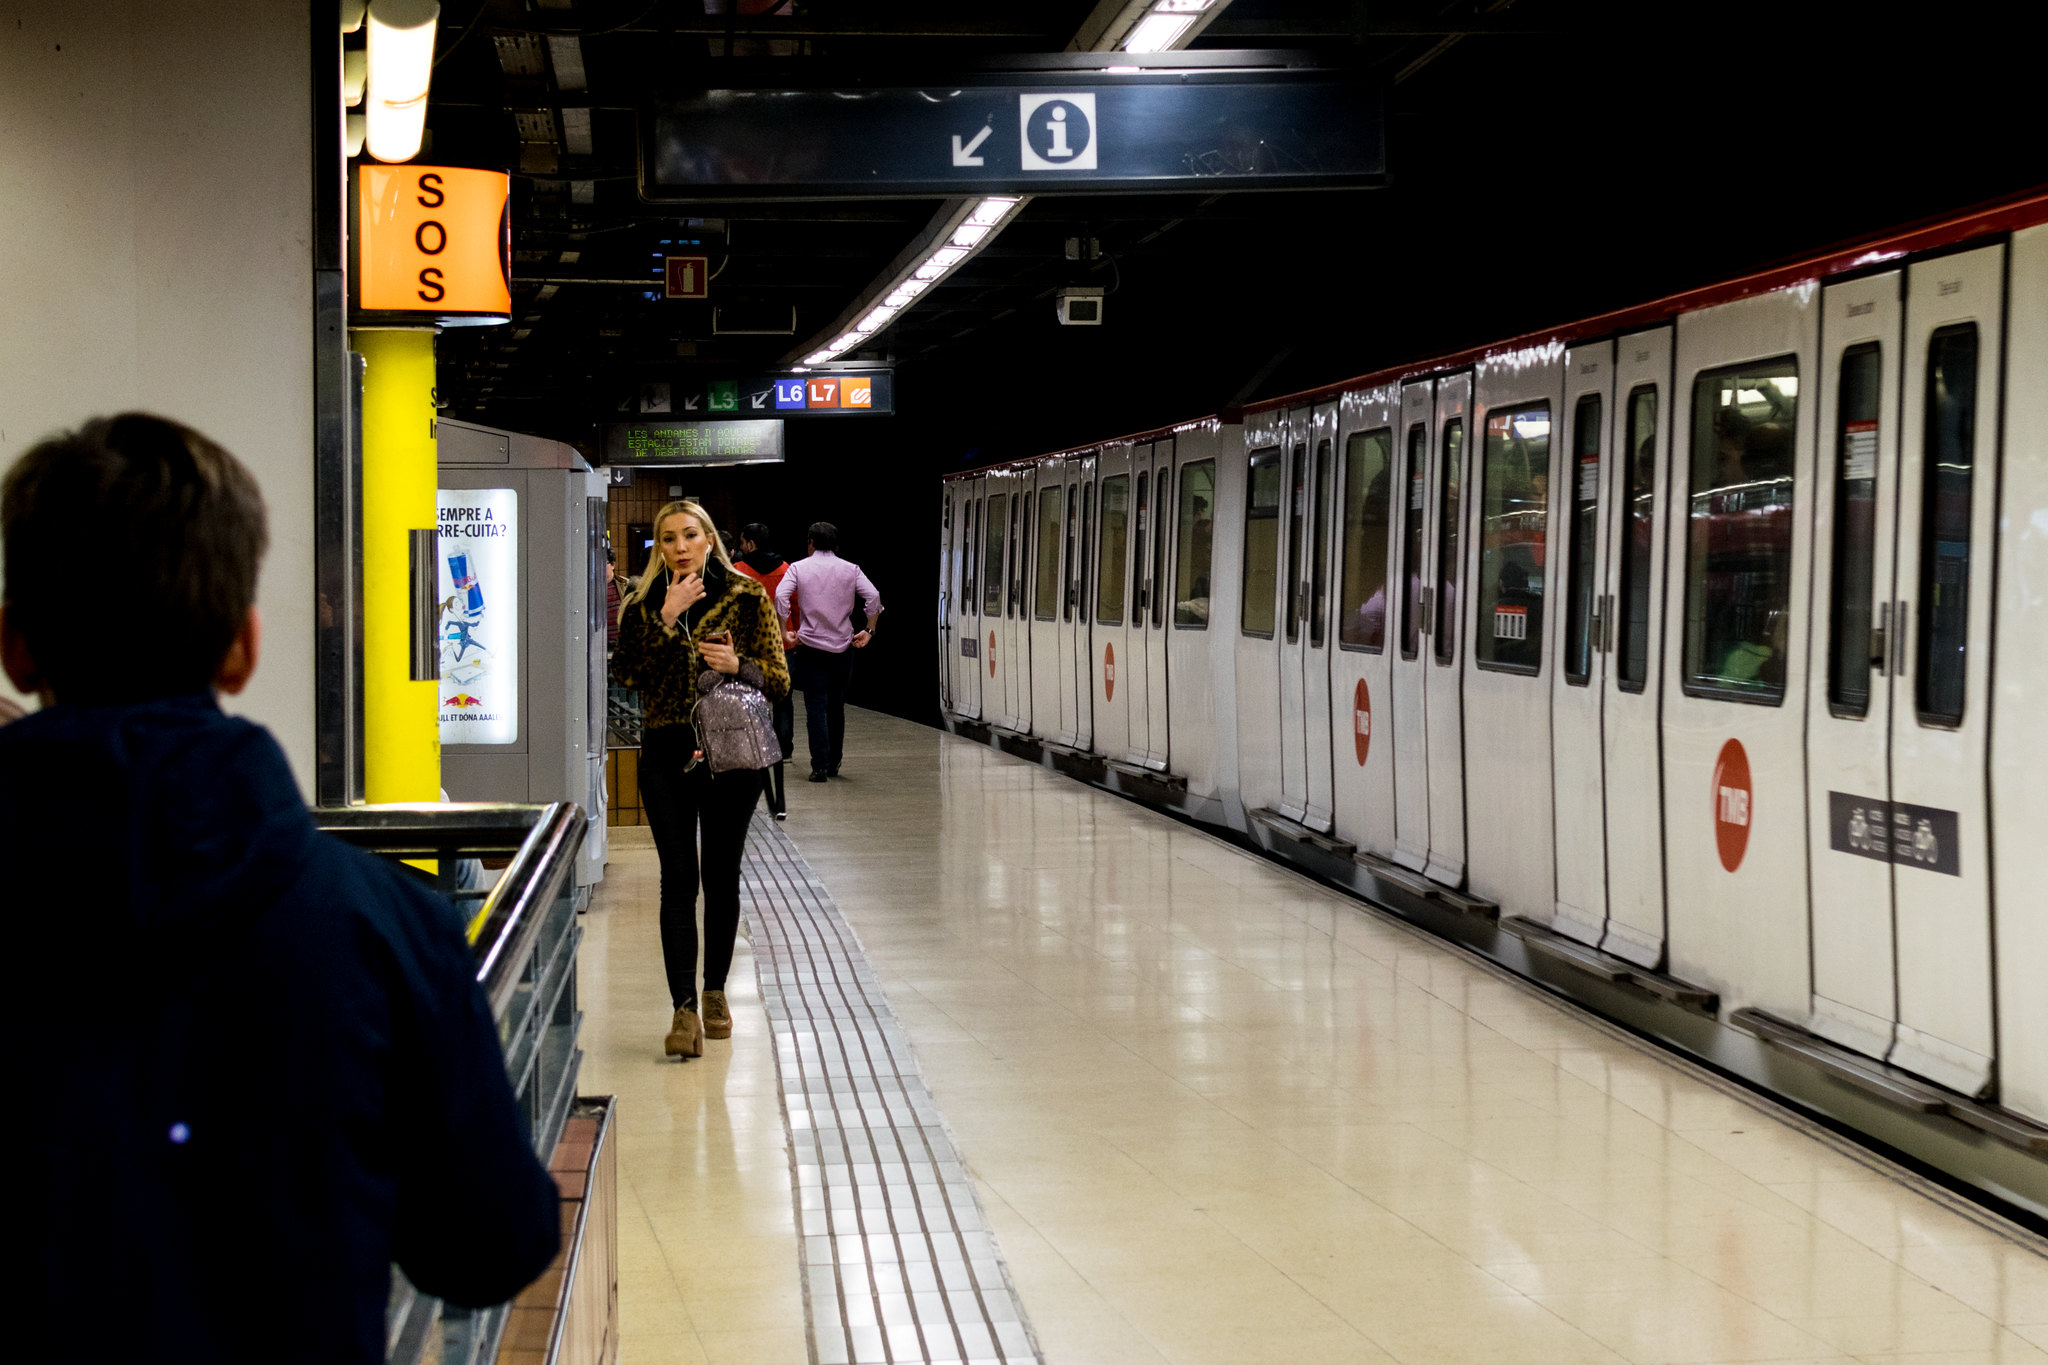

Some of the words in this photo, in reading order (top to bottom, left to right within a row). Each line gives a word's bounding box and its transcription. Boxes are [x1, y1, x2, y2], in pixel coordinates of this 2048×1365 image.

[415, 173, 447, 303] SOS
[778, 385, 803, 402] L6
[811, 384, 836, 401] L7
[710, 392, 735, 409] L3
[628, 430, 648, 439] LES
[679, 438, 712, 448] ESTAN
[635, 448, 648, 457] DE
[484, 507, 493, 521] A
[450, 713, 458, 721] ET
[1719, 785, 1749, 826] TMB
